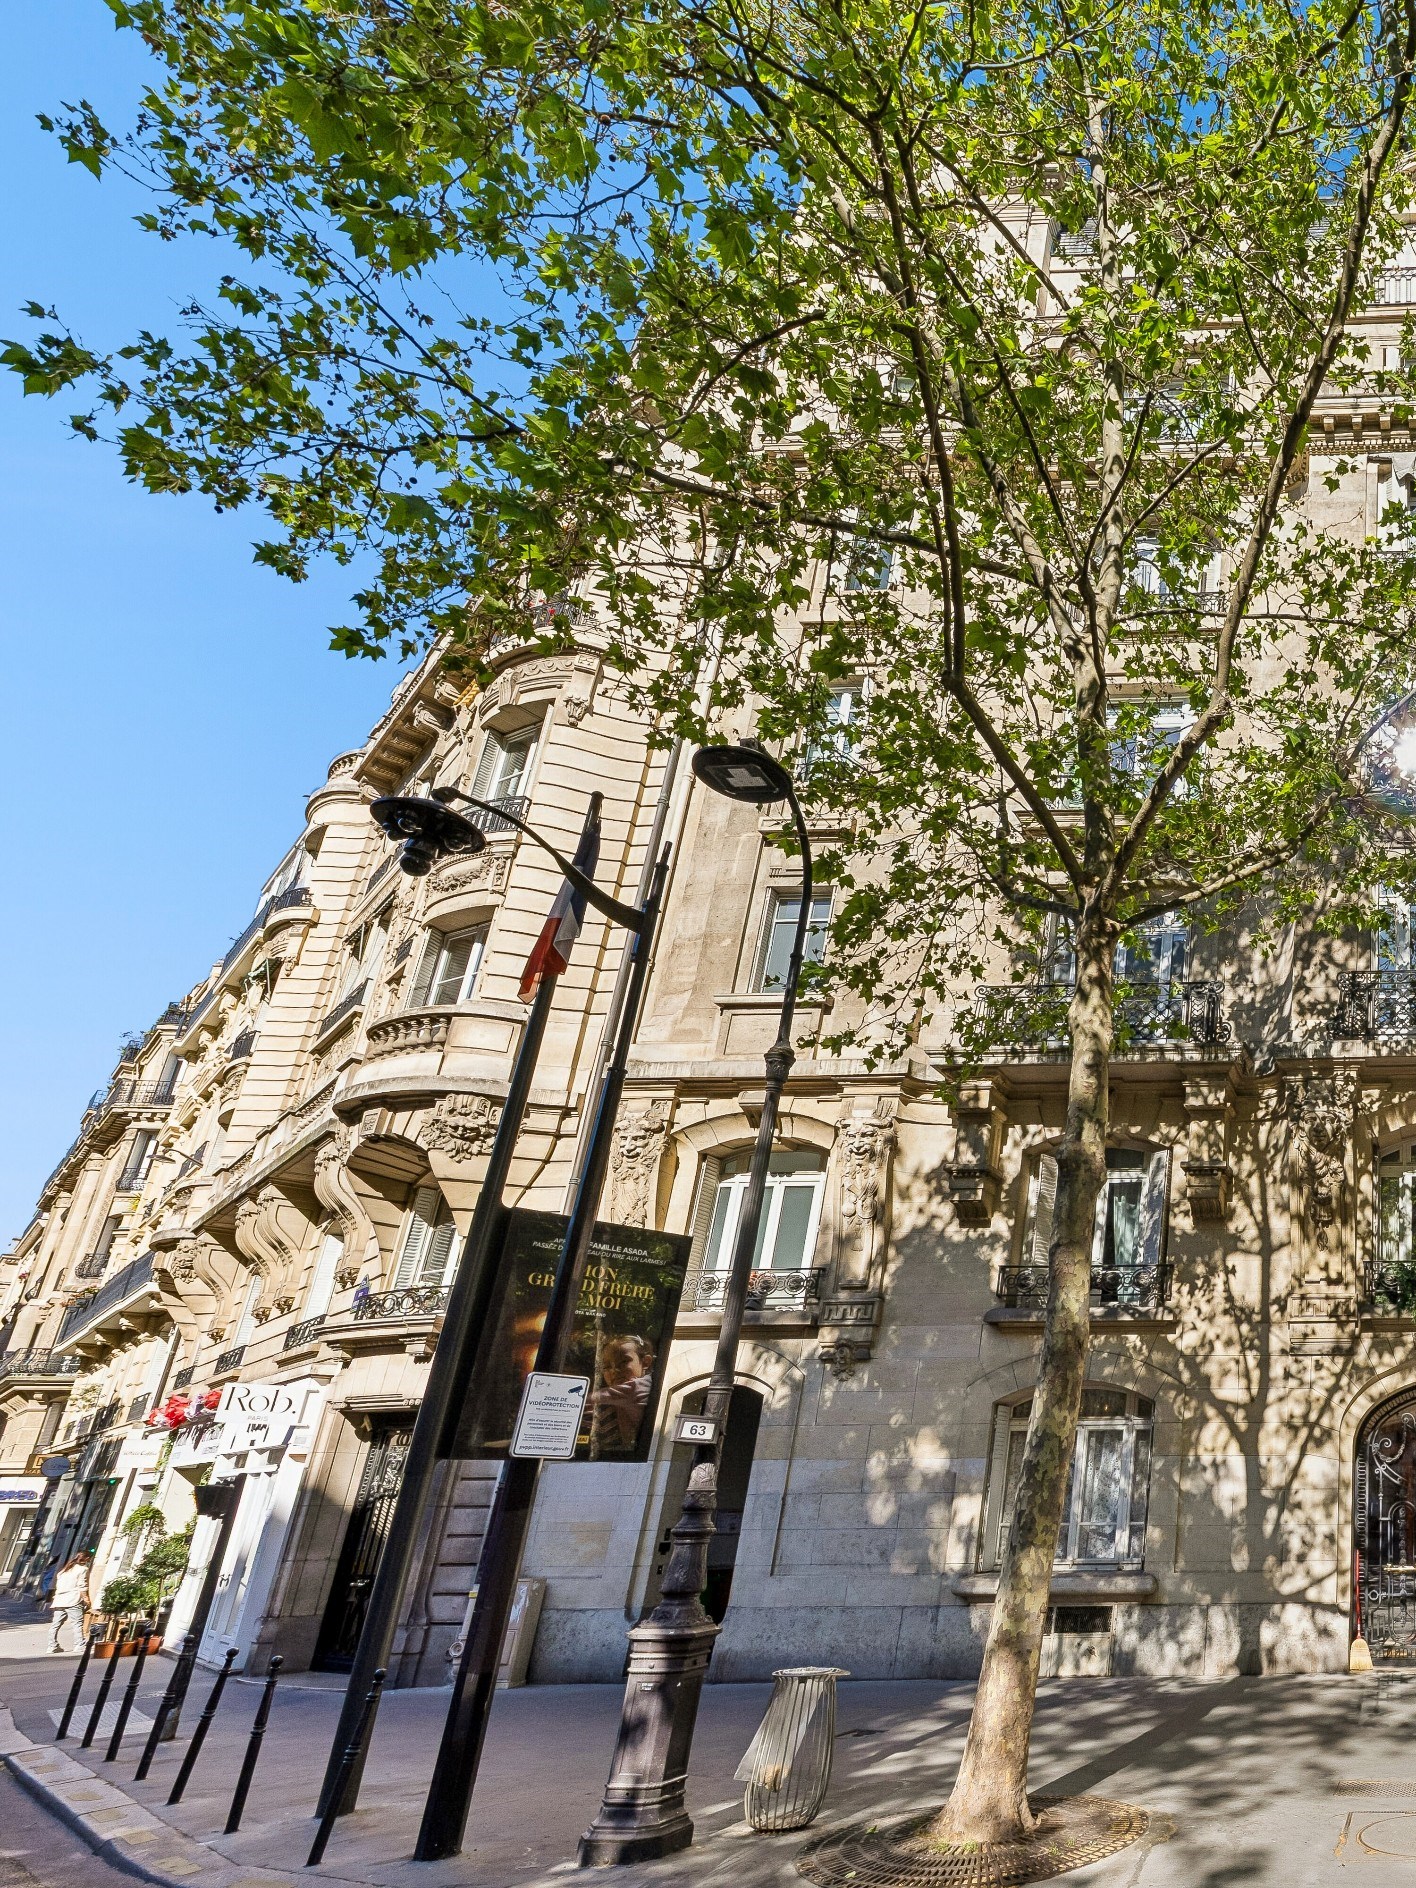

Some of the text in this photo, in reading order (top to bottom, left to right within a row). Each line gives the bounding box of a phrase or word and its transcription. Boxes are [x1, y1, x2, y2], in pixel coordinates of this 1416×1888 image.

[623, 1247, 648, 1256] ASADA
[600, 1280, 656, 1300] FRÈRE
[587, 1294, 623, 1310] MOI
[224, 1386, 296, 1414] Rob.
[529, 1400, 580, 1409] VIDÉOPROTECTION
[690, 1424, 707, 1436] 63
